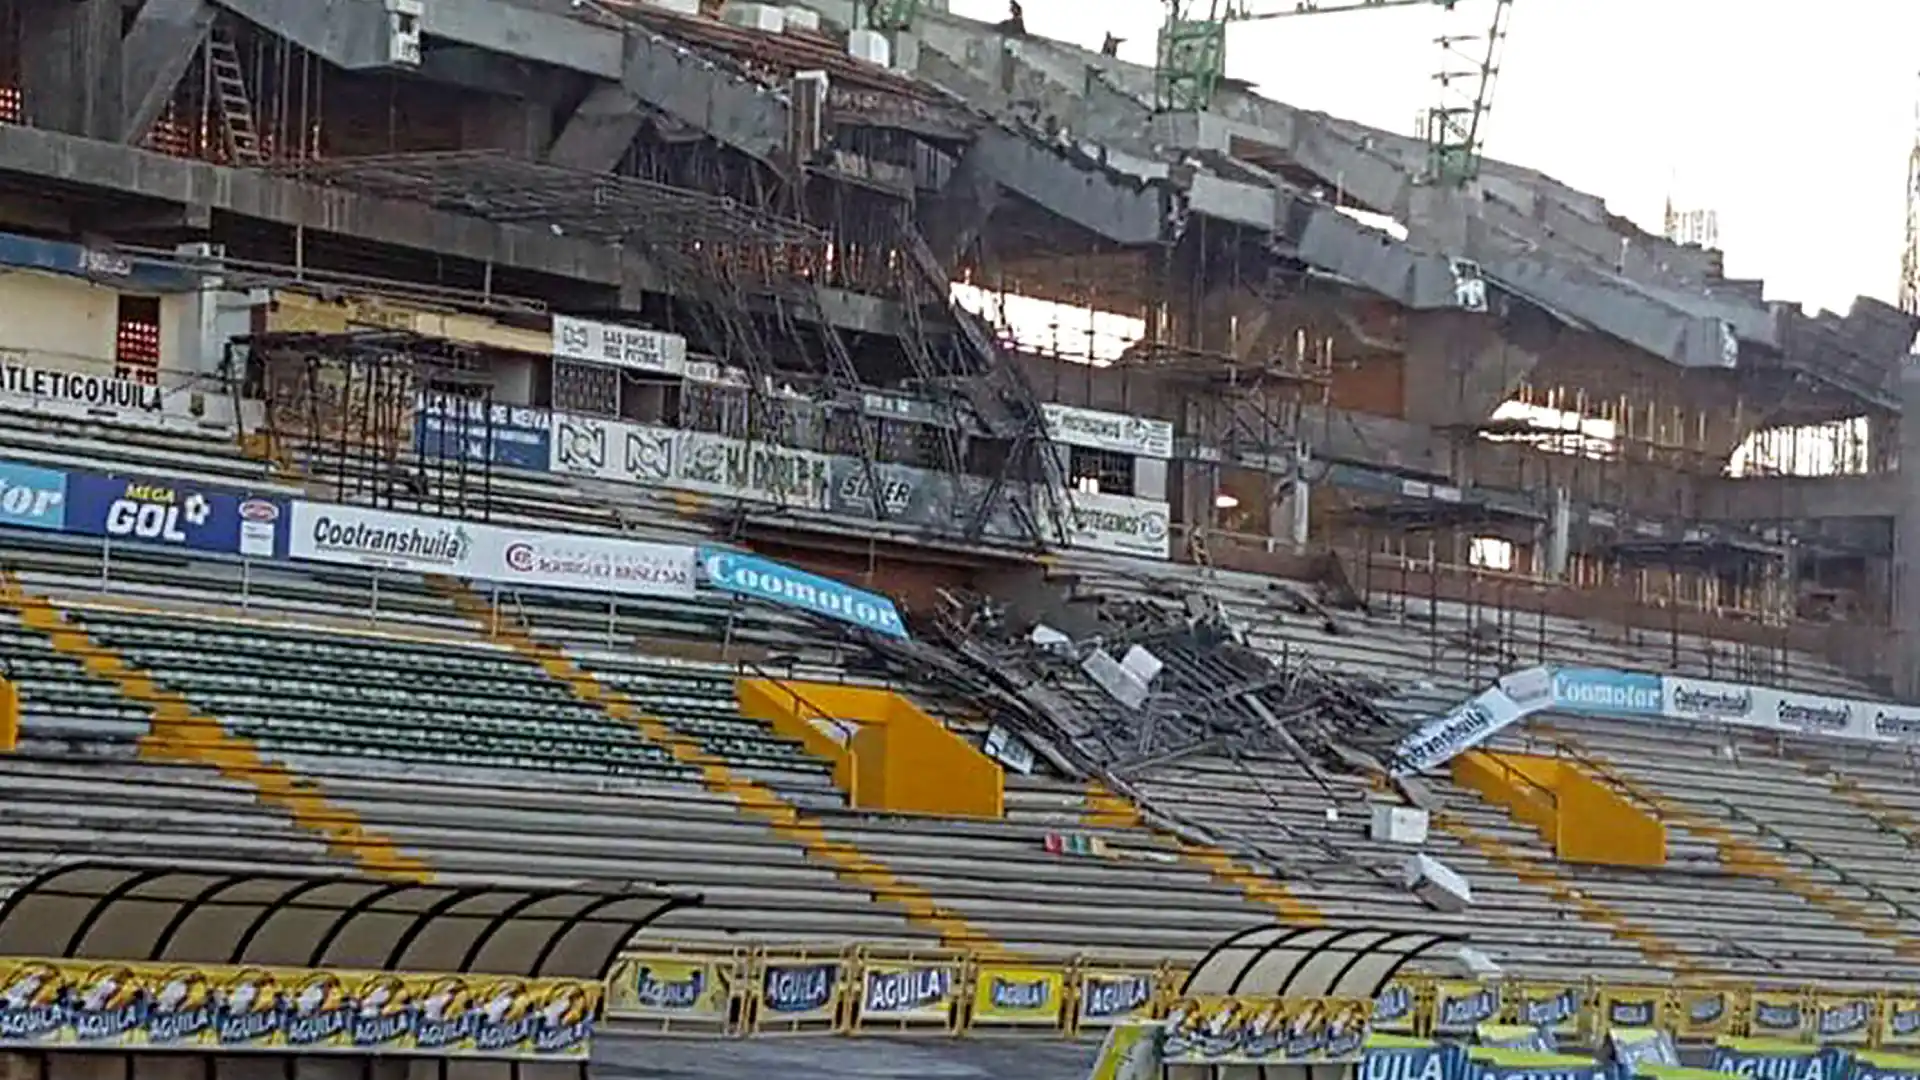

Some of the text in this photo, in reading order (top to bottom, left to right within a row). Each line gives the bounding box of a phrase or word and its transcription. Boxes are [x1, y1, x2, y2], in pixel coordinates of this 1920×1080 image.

[103, 379, 163, 412] HUILA
[125, 484, 176, 504] MEGA
[106, 500, 186, 542] GOL
[314, 516, 459, 560] Cootranshuila
[705, 552, 898, 627] Coomotor
[767, 969, 826, 999] AGUILA
[873, 968, 940, 1011] AGUILA
[1090, 976, 1146, 1014] AGUILA
[1358, 1053, 1443, 1080] UILA
